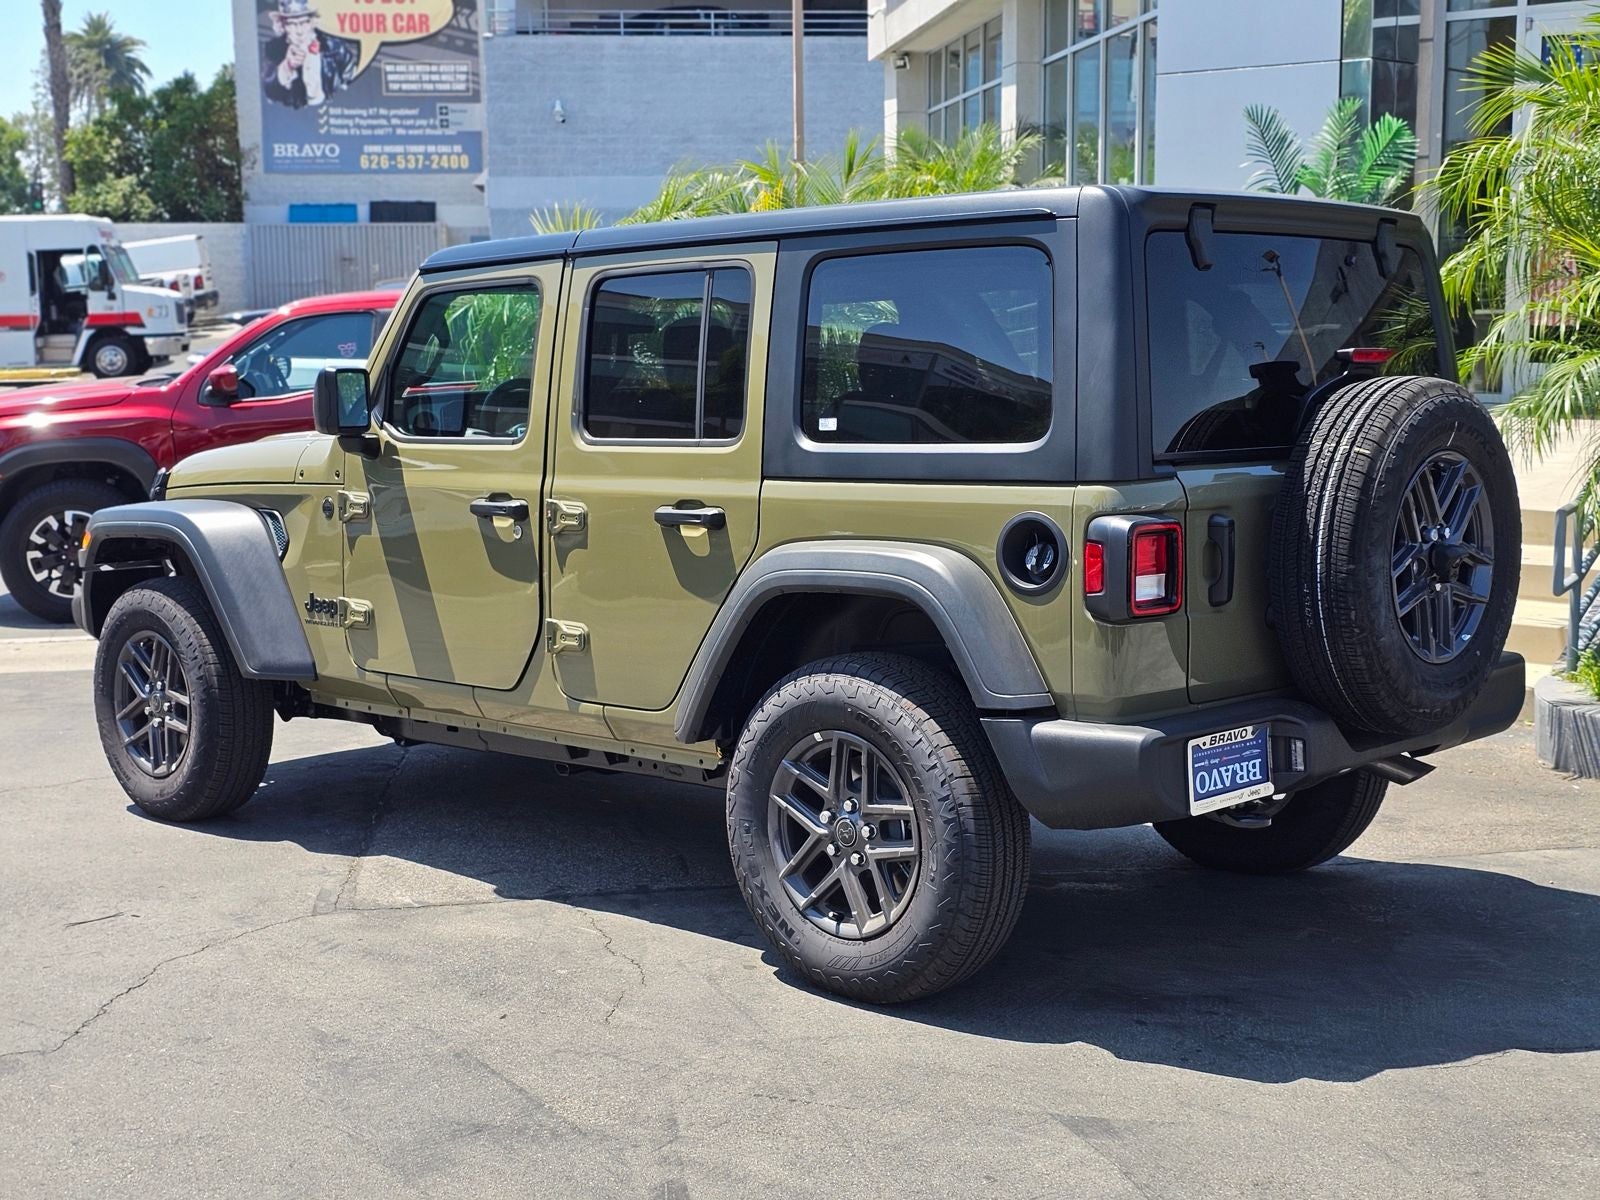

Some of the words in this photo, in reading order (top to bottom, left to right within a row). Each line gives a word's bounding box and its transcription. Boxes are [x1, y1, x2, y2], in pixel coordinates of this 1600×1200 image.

[336, 12, 387, 33] YOUR
[392, 12, 431, 33] CAR
[272, 143, 340, 157] BRAVO
[359, 154, 470, 170] 626-537-2400
[304, 591, 339, 618] Jeep
[1209, 728, 1248, 746] BRAVO
[1195, 758, 1263, 794] BRAVO
